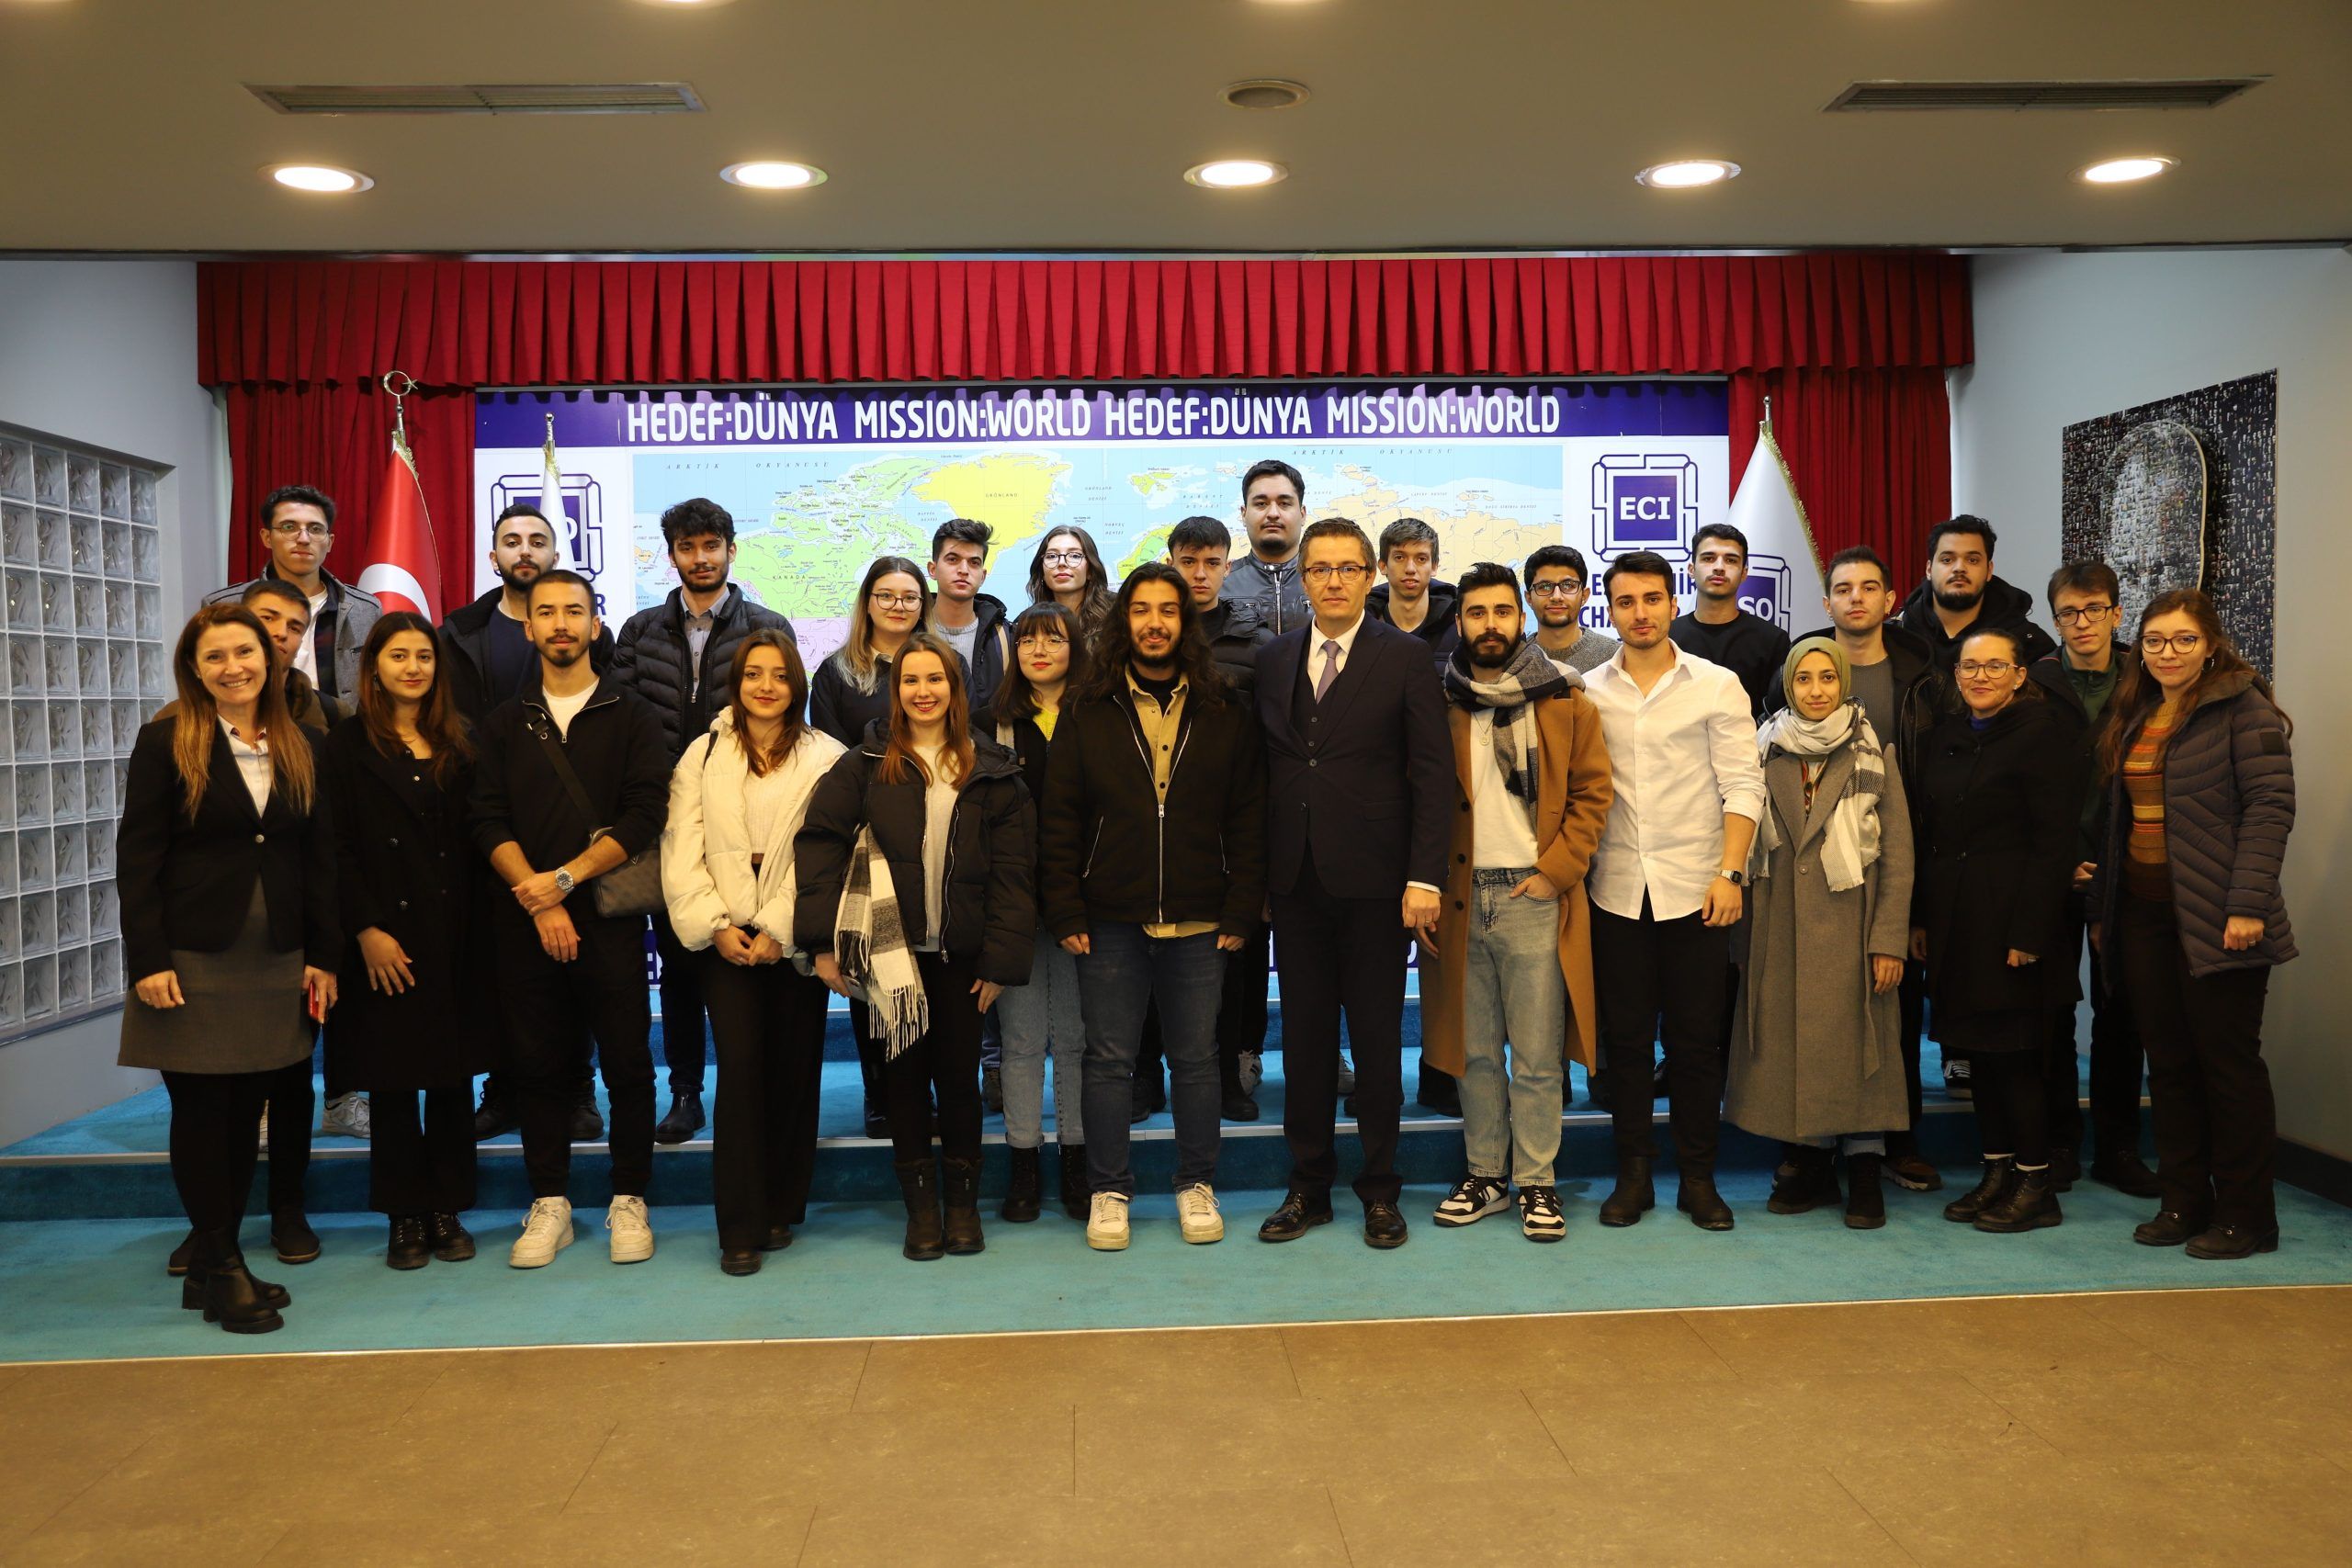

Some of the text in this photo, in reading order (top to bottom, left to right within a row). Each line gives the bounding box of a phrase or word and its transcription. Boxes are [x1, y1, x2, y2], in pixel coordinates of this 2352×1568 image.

[628, 388, 1560, 442] HEDEF:DÜNYA MISSION:WORLD HEDEF:DÜNYA MISSION:WORLD
[1620, 496, 1671, 520] ECI
[1737, 595, 1774, 622] SO
